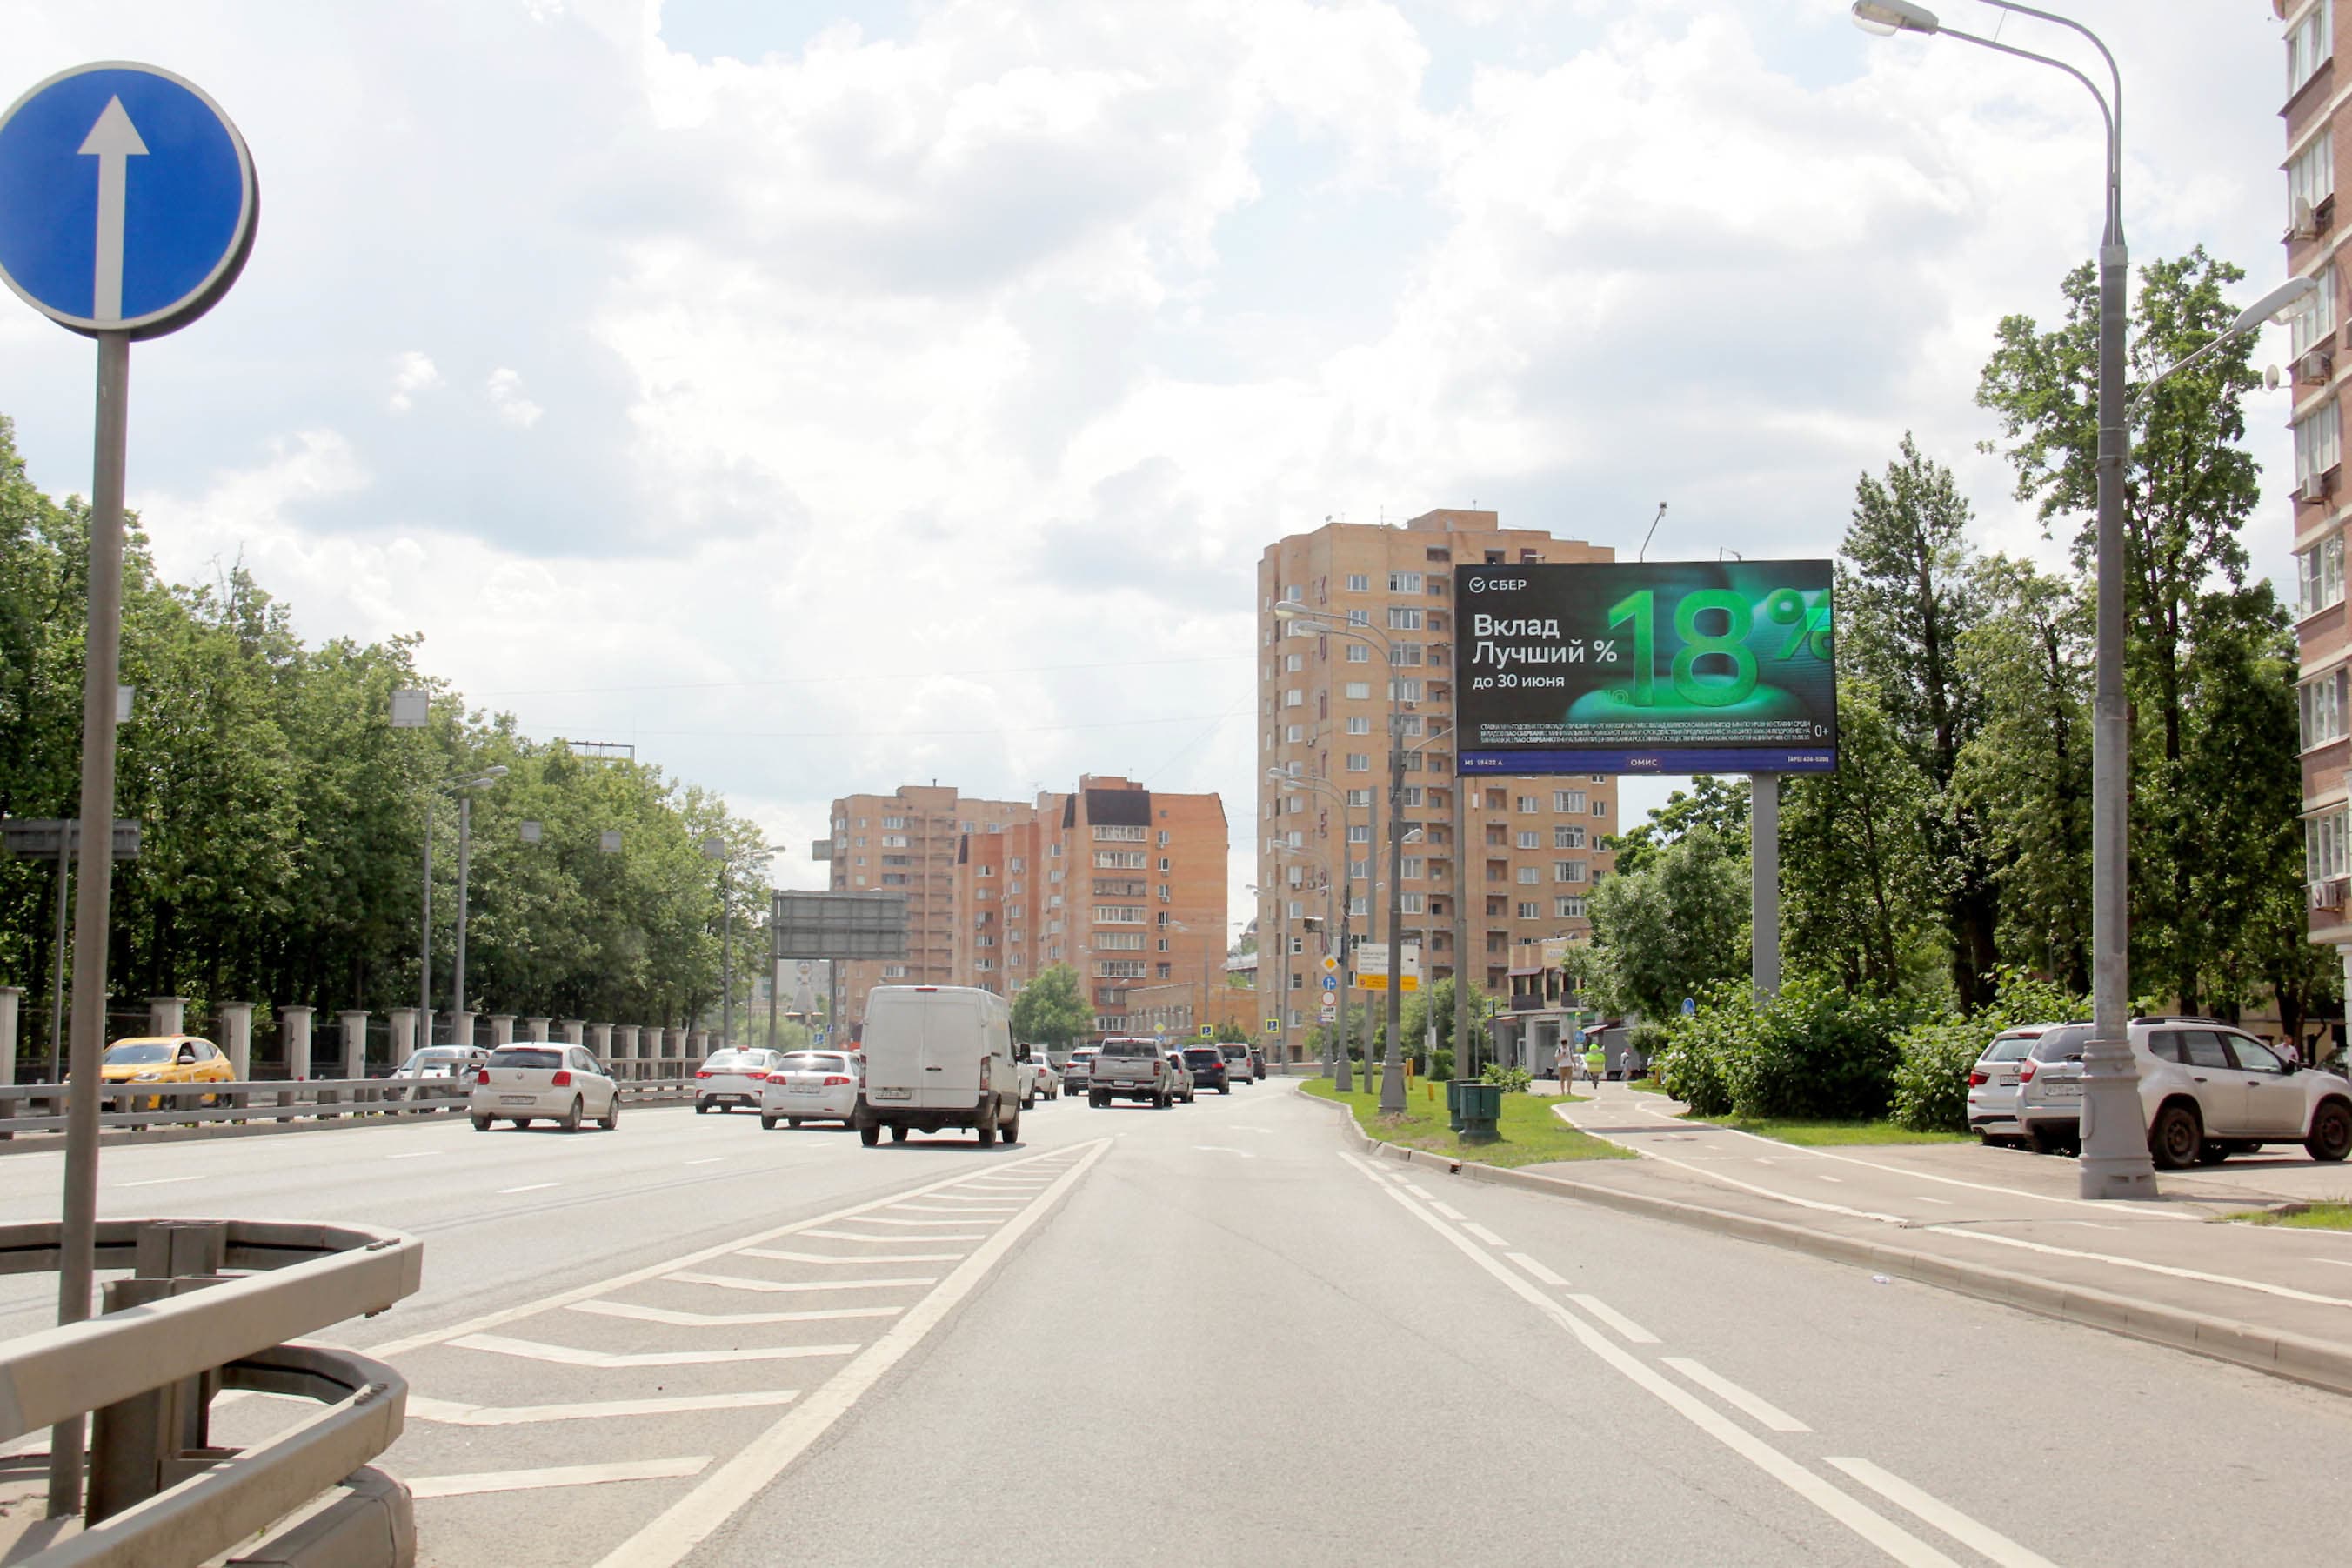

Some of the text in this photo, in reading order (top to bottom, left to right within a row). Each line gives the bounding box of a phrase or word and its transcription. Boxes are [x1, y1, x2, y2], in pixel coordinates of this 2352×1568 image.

[1488, 579, 1527, 591] СБЕР
[1473, 613, 1560, 639] Вклад
[1472, 638, 1618, 670] Лучший %
[1473, 674, 1565, 690] до 30 июня
[1814, 724, 1829, 737] 0+
